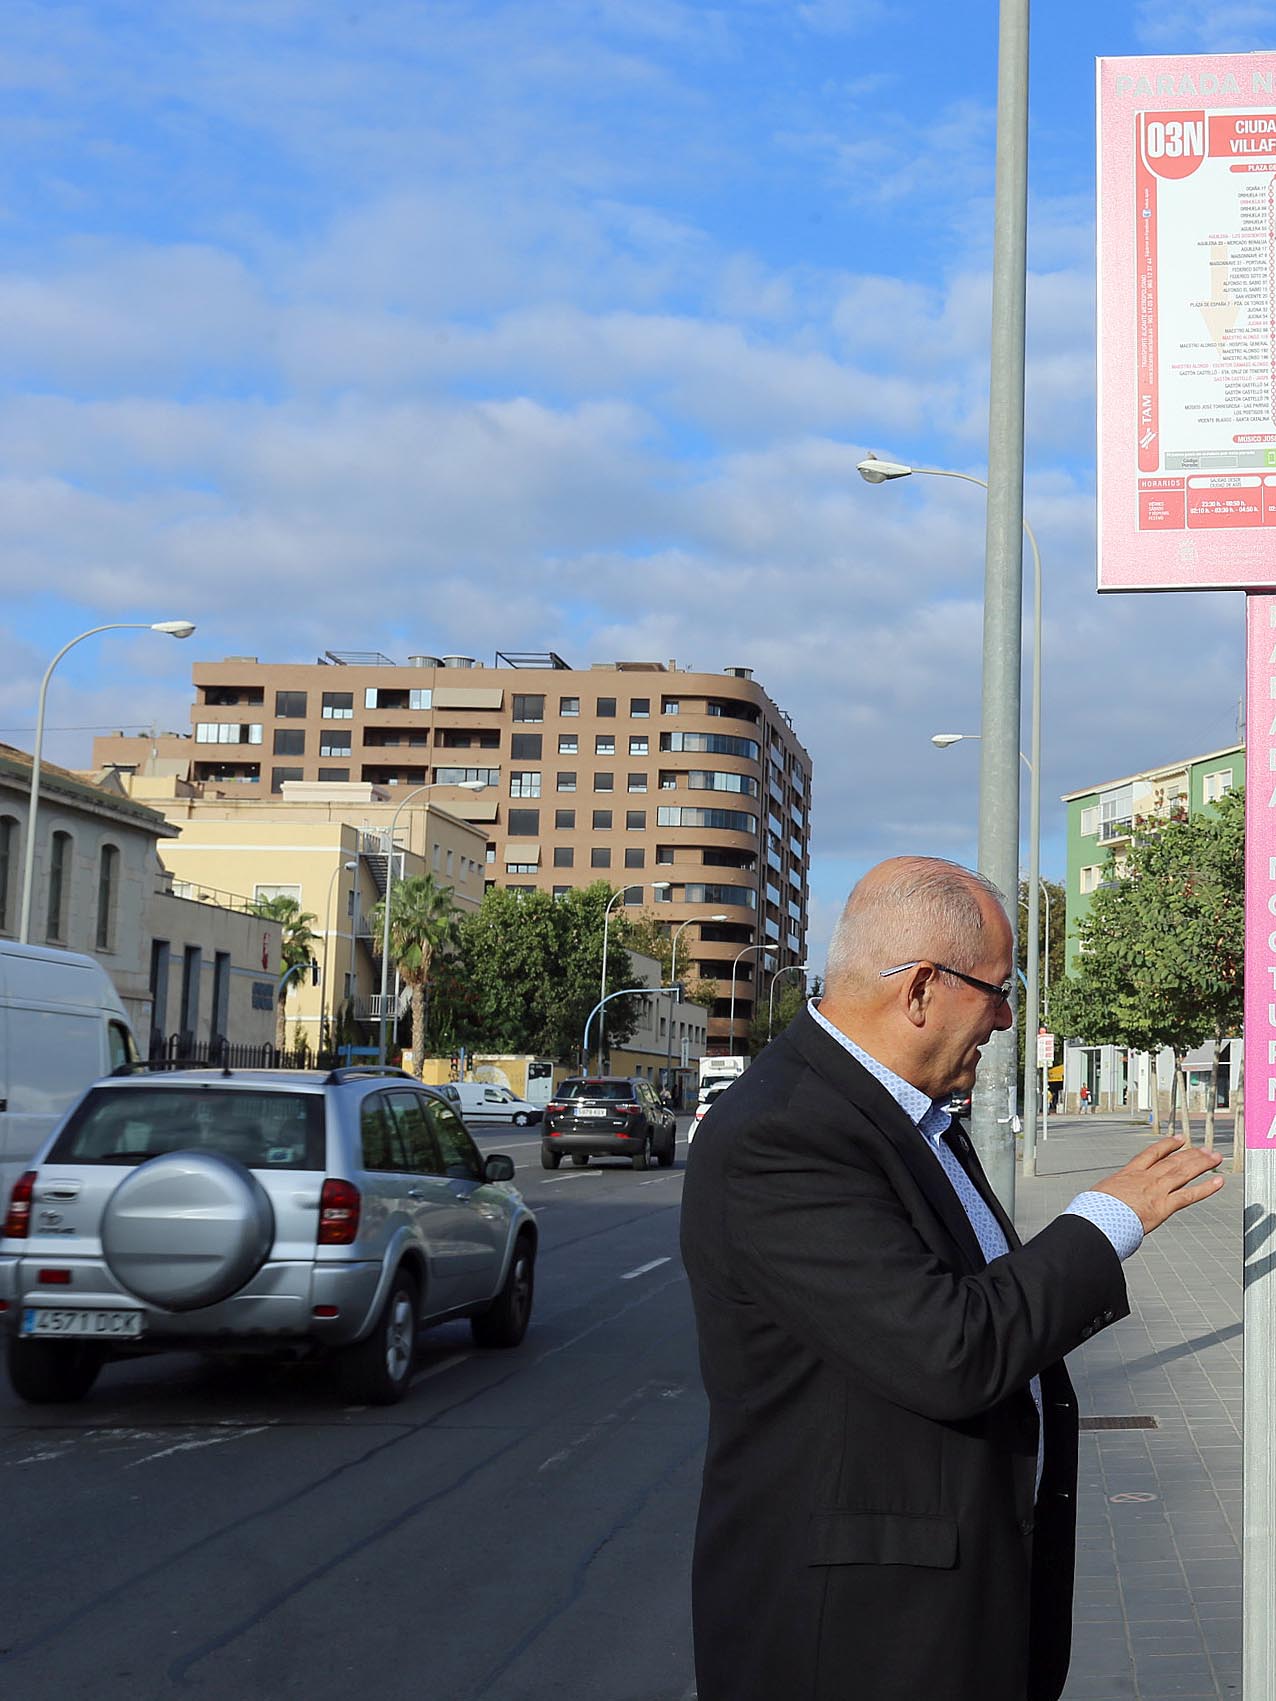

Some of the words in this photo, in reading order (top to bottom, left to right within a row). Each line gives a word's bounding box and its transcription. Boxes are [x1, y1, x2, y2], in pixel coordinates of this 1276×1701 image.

[1115, 73, 1241, 97] PARADA
[1147, 121, 1204, 158] 03N
[1248, 164, 1267, 172] PLAZA
[1142, 395, 1153, 425] TAM
[1141, 479, 1181, 487] HORARIOS
[36, 1311, 90, 1331] 4571
